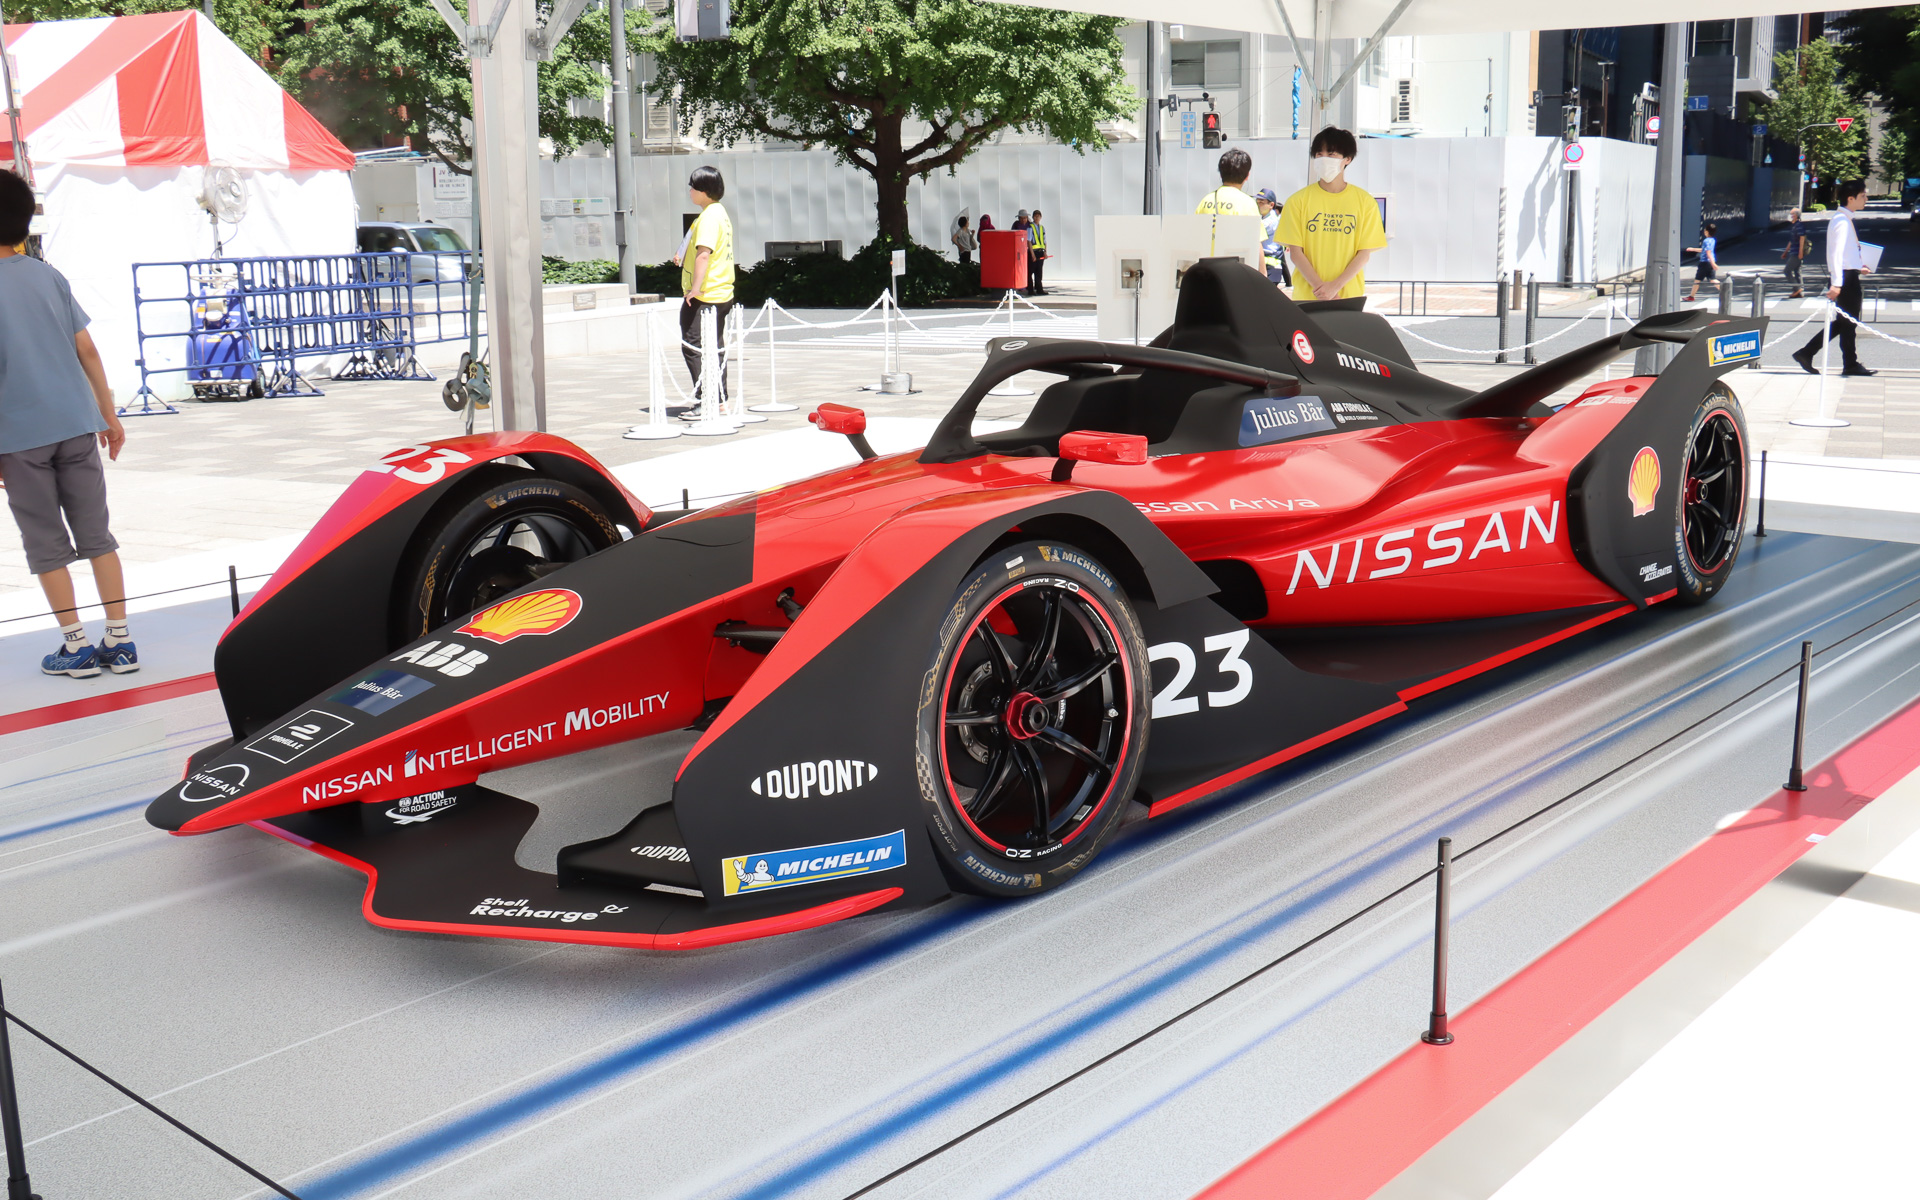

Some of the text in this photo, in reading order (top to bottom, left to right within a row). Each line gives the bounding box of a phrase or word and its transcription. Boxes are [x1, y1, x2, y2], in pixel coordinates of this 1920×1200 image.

[1723, 340, 1756, 355] MICHELIN
[1250, 401, 1326, 436] Julius Bär
[508, 486, 560, 500] MICHELIN
[1229, 498, 1320, 511] Ariya
[1285, 500, 1560, 596] NISSAN
[1062, 551, 1113, 589] MICHELIN
[1023, 577, 1049, 587] RACING
[390, 640, 489, 677] ABB
[1147, 628, 1253, 719] 23
[352, 680, 403, 700] Julius Bär
[302, 691, 670, 804] NISSAN INTELLIGENT MOBILITY
[190, 773, 240, 796] NISSAN
[766, 759, 865, 799] DUPONT
[411, 803, 430, 813] ROAD
[431, 796, 457, 808] SAFETY
[412, 790, 445, 805] ACTION
[1036, 843, 1063, 857] RACING
[776, 846, 893, 877] MICHELIN
[964, 856, 1022, 886] MICHELIN
[480, 898, 529, 907] Shell
[469, 904, 598, 923] Recharge
